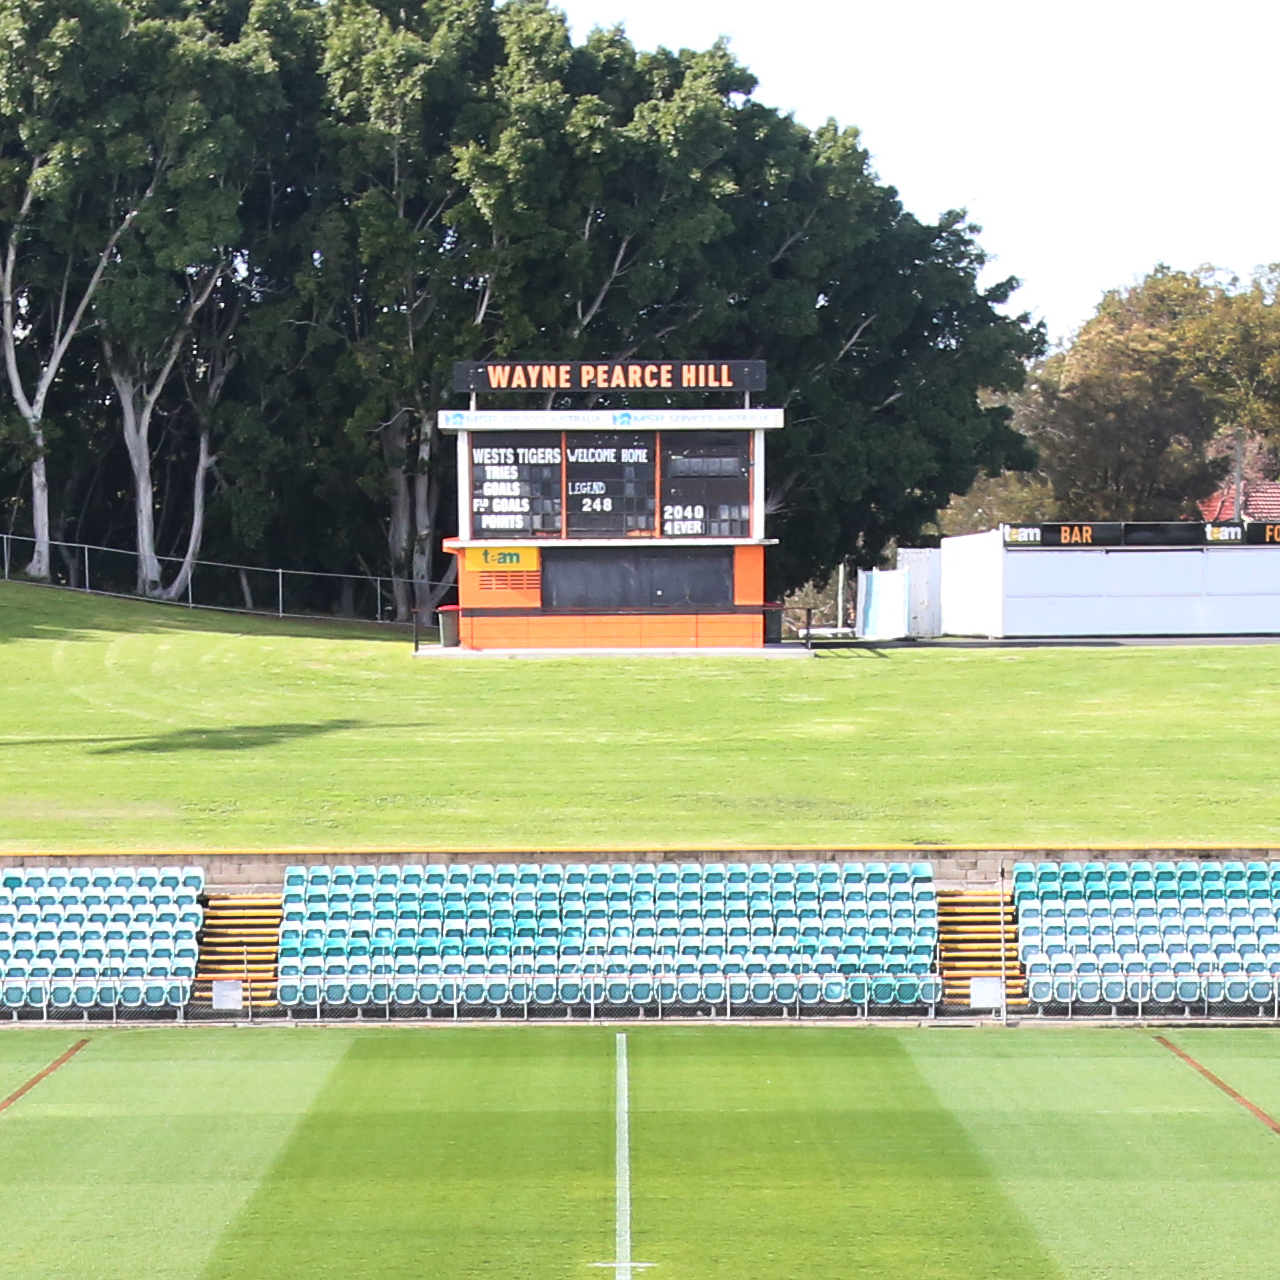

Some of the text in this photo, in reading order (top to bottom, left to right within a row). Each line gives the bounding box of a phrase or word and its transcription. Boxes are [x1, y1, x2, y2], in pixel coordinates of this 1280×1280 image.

[487, 364, 734, 389] WAYNE PEARCE HILL
[472, 448, 562, 464] WESTS TIGERS
[566, 448, 649, 463] WELCOME HOME
[484, 465, 518, 480] TRIES
[483, 481, 520, 496] GOALS
[568, 481, 606, 495] LEGEND
[492, 498, 530, 512] GOALS
[581, 497, 613, 512] 248
[663, 505, 704, 520] 2040
[481, 514, 524, 529] POINTS
[1003, 524, 1041, 542] team
[1060, 526, 1092, 544] BAR
[1204, 523, 1242, 541] team
